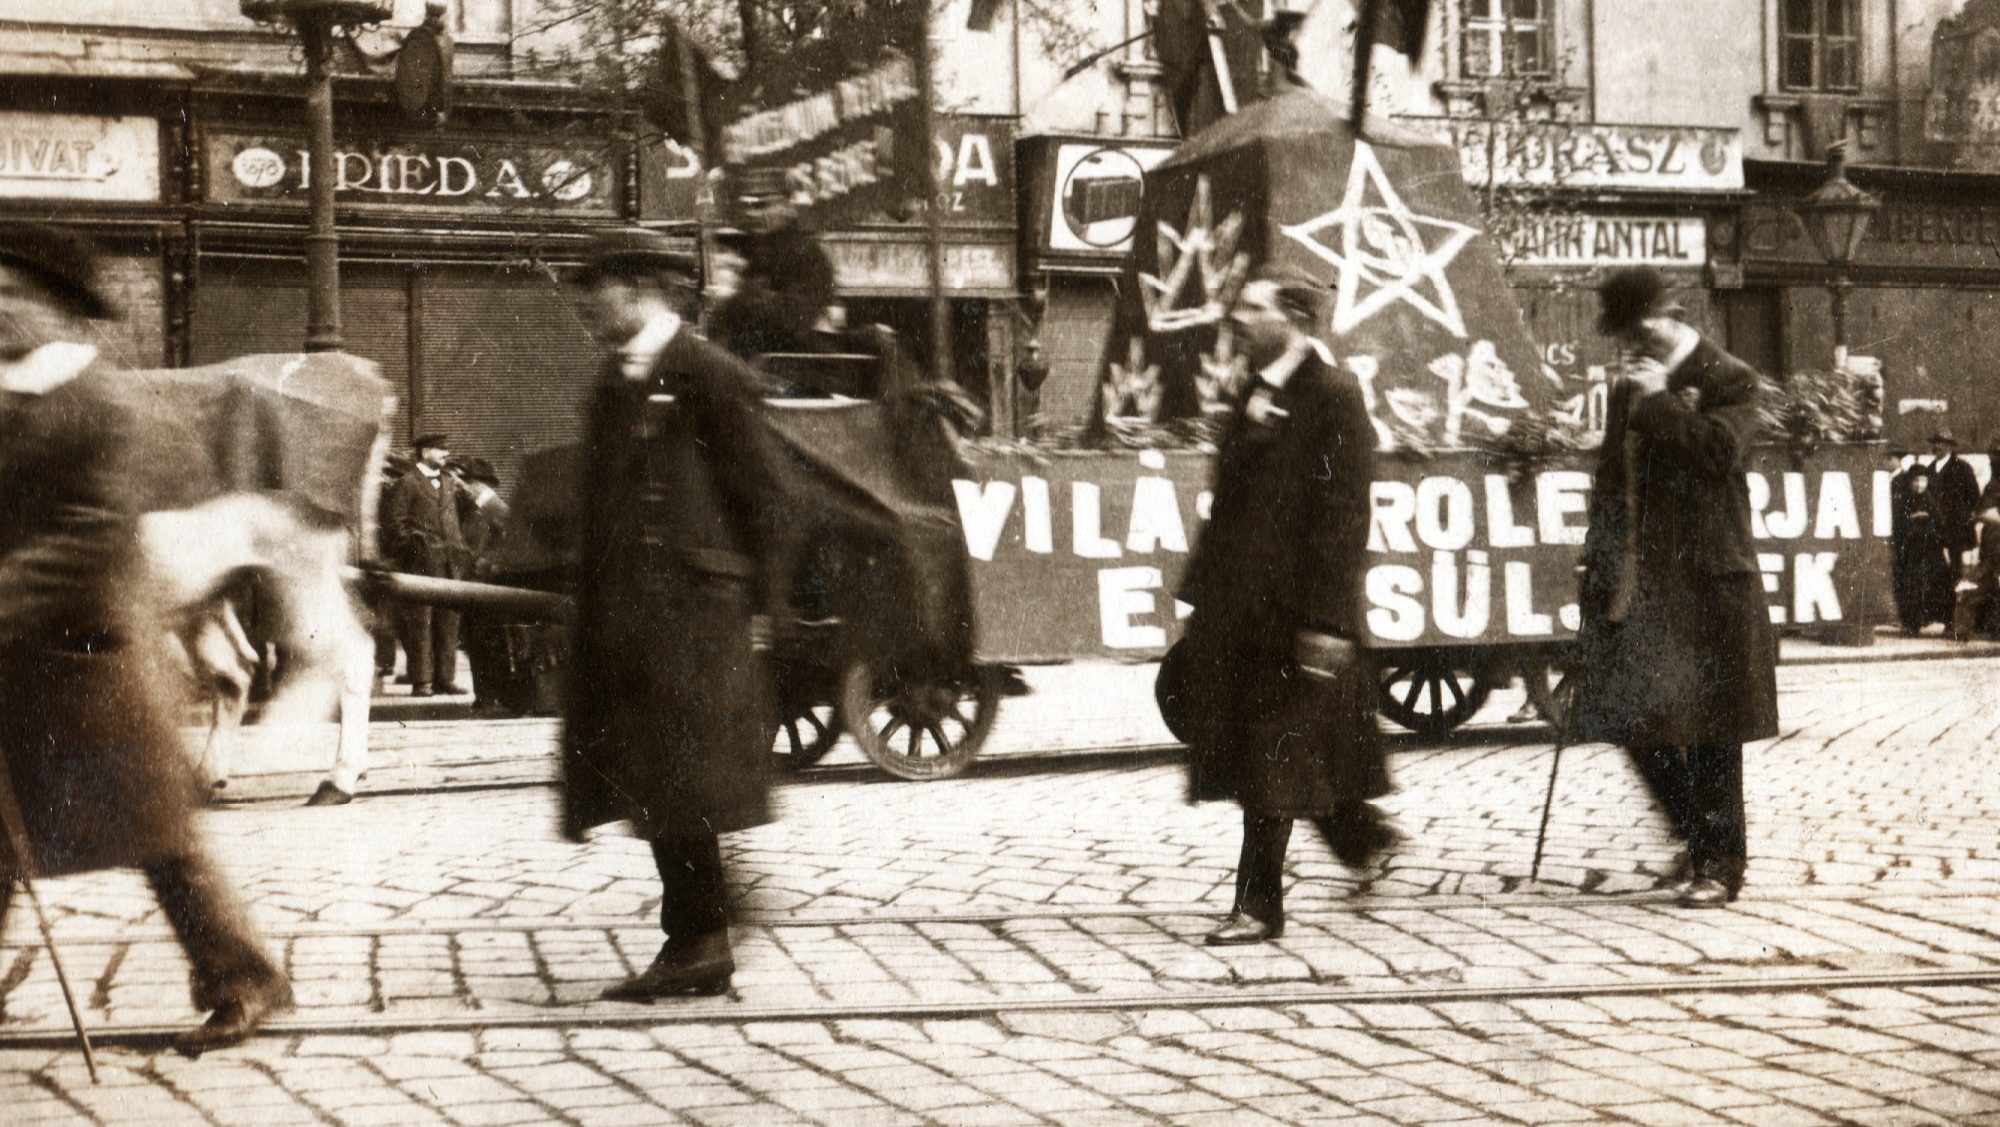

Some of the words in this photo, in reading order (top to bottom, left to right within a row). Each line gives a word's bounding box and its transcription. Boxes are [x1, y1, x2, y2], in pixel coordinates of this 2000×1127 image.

[485, 159, 540, 198] A.
[1592, 220, 1689, 259] ANTAL
[951, 450, 1214, 562] VILÁ
